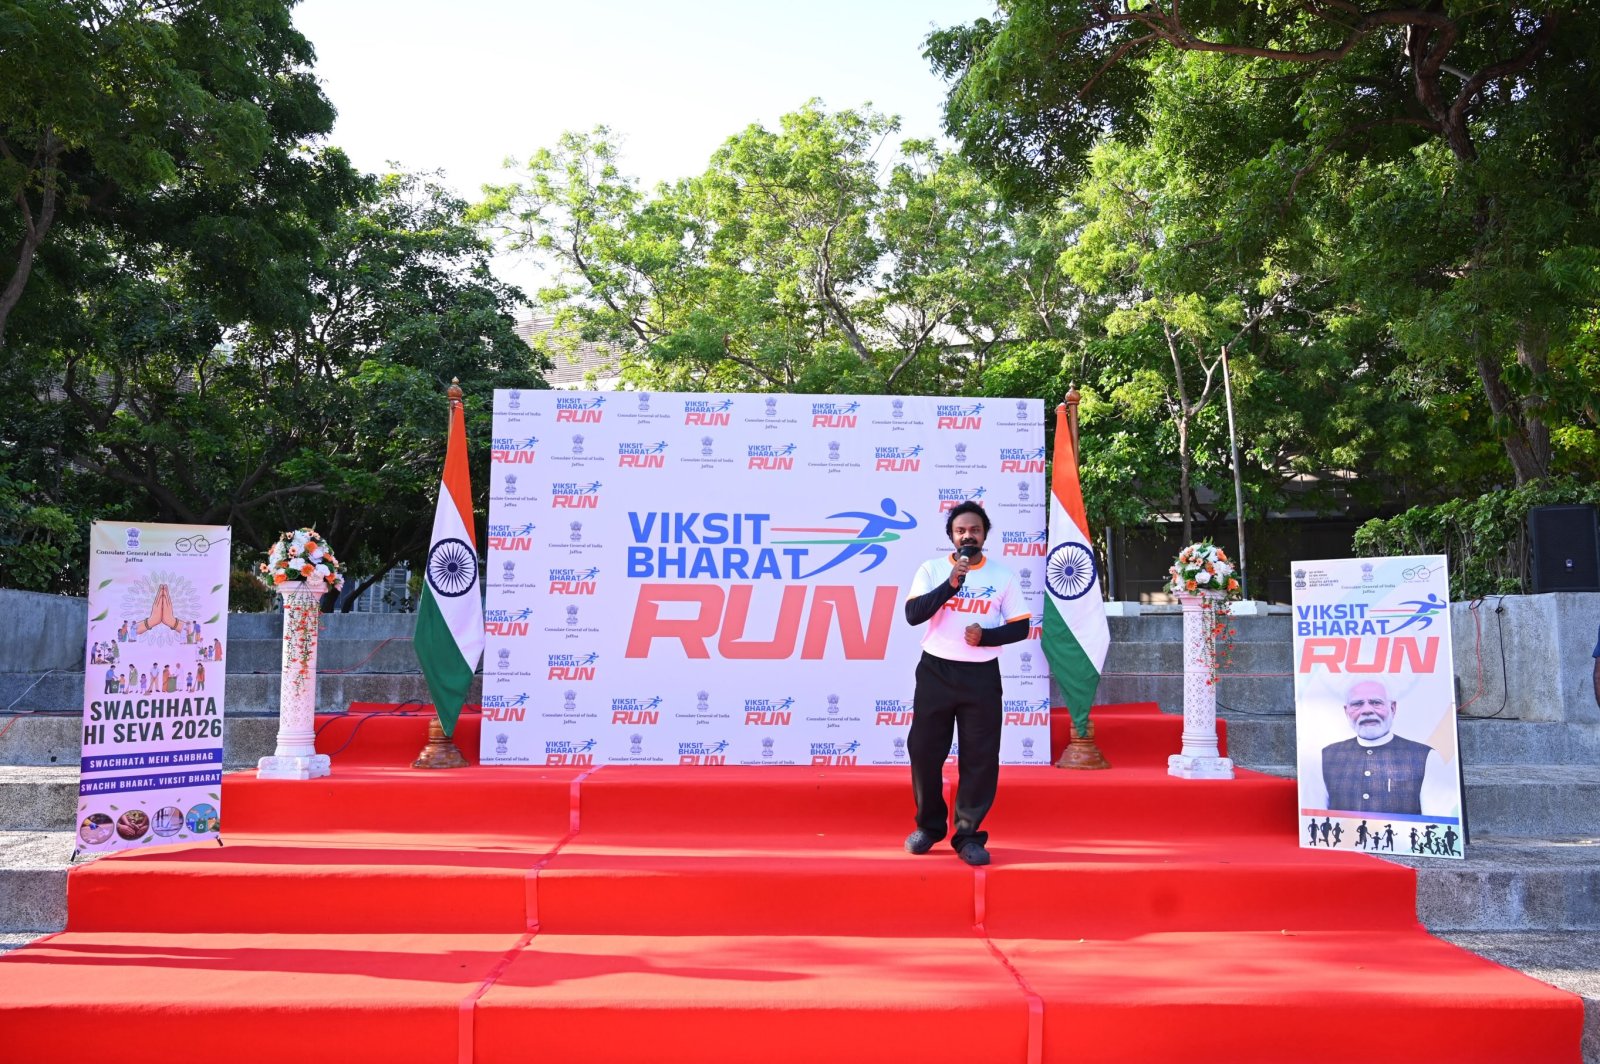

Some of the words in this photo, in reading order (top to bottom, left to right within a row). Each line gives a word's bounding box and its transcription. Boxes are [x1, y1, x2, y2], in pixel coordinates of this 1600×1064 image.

[556, 410, 602, 423] RUN
[684, 413, 730, 426] RUN
[813, 415, 857, 428] RUN
[937, 417, 981, 429] RUN
[619, 454, 664, 468] RUN
[748, 457, 794, 470] RUN
[875, 459, 920, 471] RUN
[1000, 460, 1045, 473] RUN
[552, 495, 598, 508] RUN
[628, 512, 770, 544] VIKSIT
[1002, 543, 1047, 556] RUN
[627, 546, 808, 579] BHARAT
[549, 581, 596, 595] RUN
[1297, 604, 1368, 619] VIKSIT
[625, 584, 898, 659] RUN
[1298, 620, 1389, 636] BHARAT
[1299, 637, 1440, 673] RUN
[547, 667, 596, 680] RUN
[91, 697, 216, 721] SWACHHATA
[612, 711, 659, 724] RUN
[745, 712, 791, 725] RUN
[1003, 712, 1048, 725] RUN
[84, 725, 104, 745] HI
[113, 722, 164, 743] SEVA
[172, 719, 221, 739] 2026
[90, 757, 144, 768] SWACHHATA
[148, 754, 169, 764] MEIN
[173, 752, 213, 762] SAHBHAG
[81, 780, 116, 792] SWACHH
[120, 779, 155, 788] BHARAT,
[159, 775, 185, 785] VIKSIT
[189, 774, 220, 783] BHARAT
